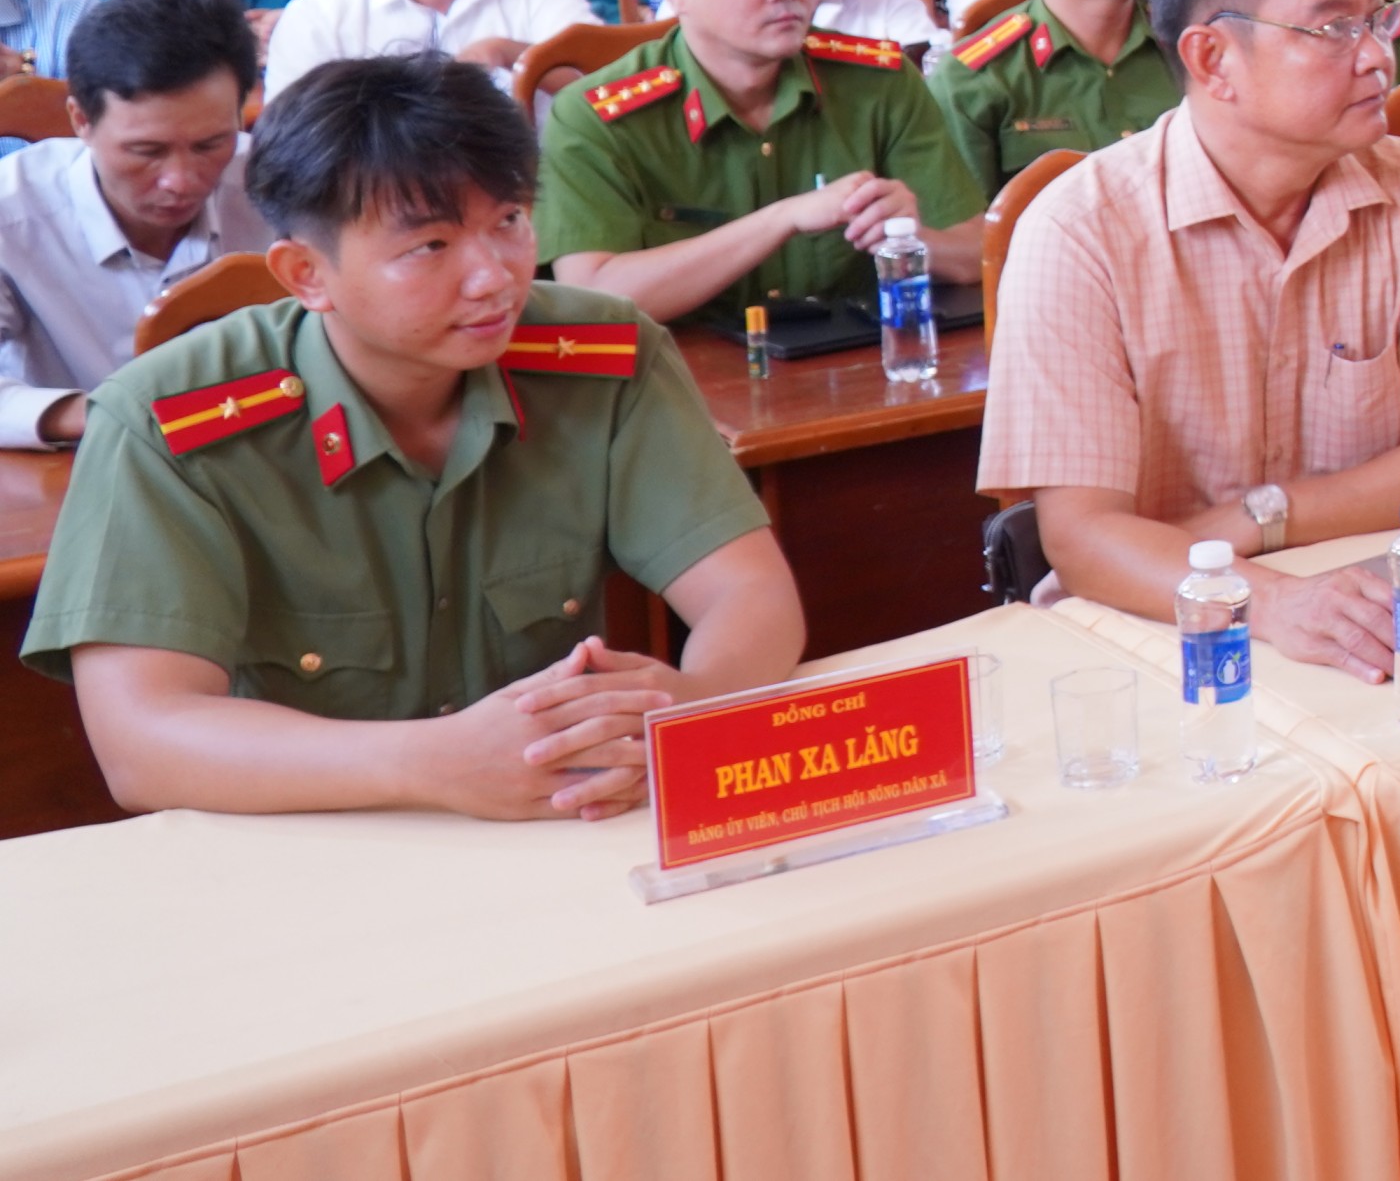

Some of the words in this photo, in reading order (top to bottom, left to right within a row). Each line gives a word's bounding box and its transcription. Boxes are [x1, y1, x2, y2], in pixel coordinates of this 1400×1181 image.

[772, 703, 826, 727] ĐỒNG
[831, 691, 867, 714] CHÍ
[716, 752, 791, 799] PHAN
[799, 743, 840, 780] XA
[845, 724, 920, 770] LĂNG
[688, 823, 724, 846] ĐẢNG
[727, 816, 744, 836] ỦY
[781, 801, 808, 823] CHỦ
[811, 797, 841, 819] TỊCH
[843, 789, 866, 811] HỘI
[868, 784, 900, 804] NÔNG
[903, 775, 928, 795] DÂN
[929, 770, 948, 788] XÃ
